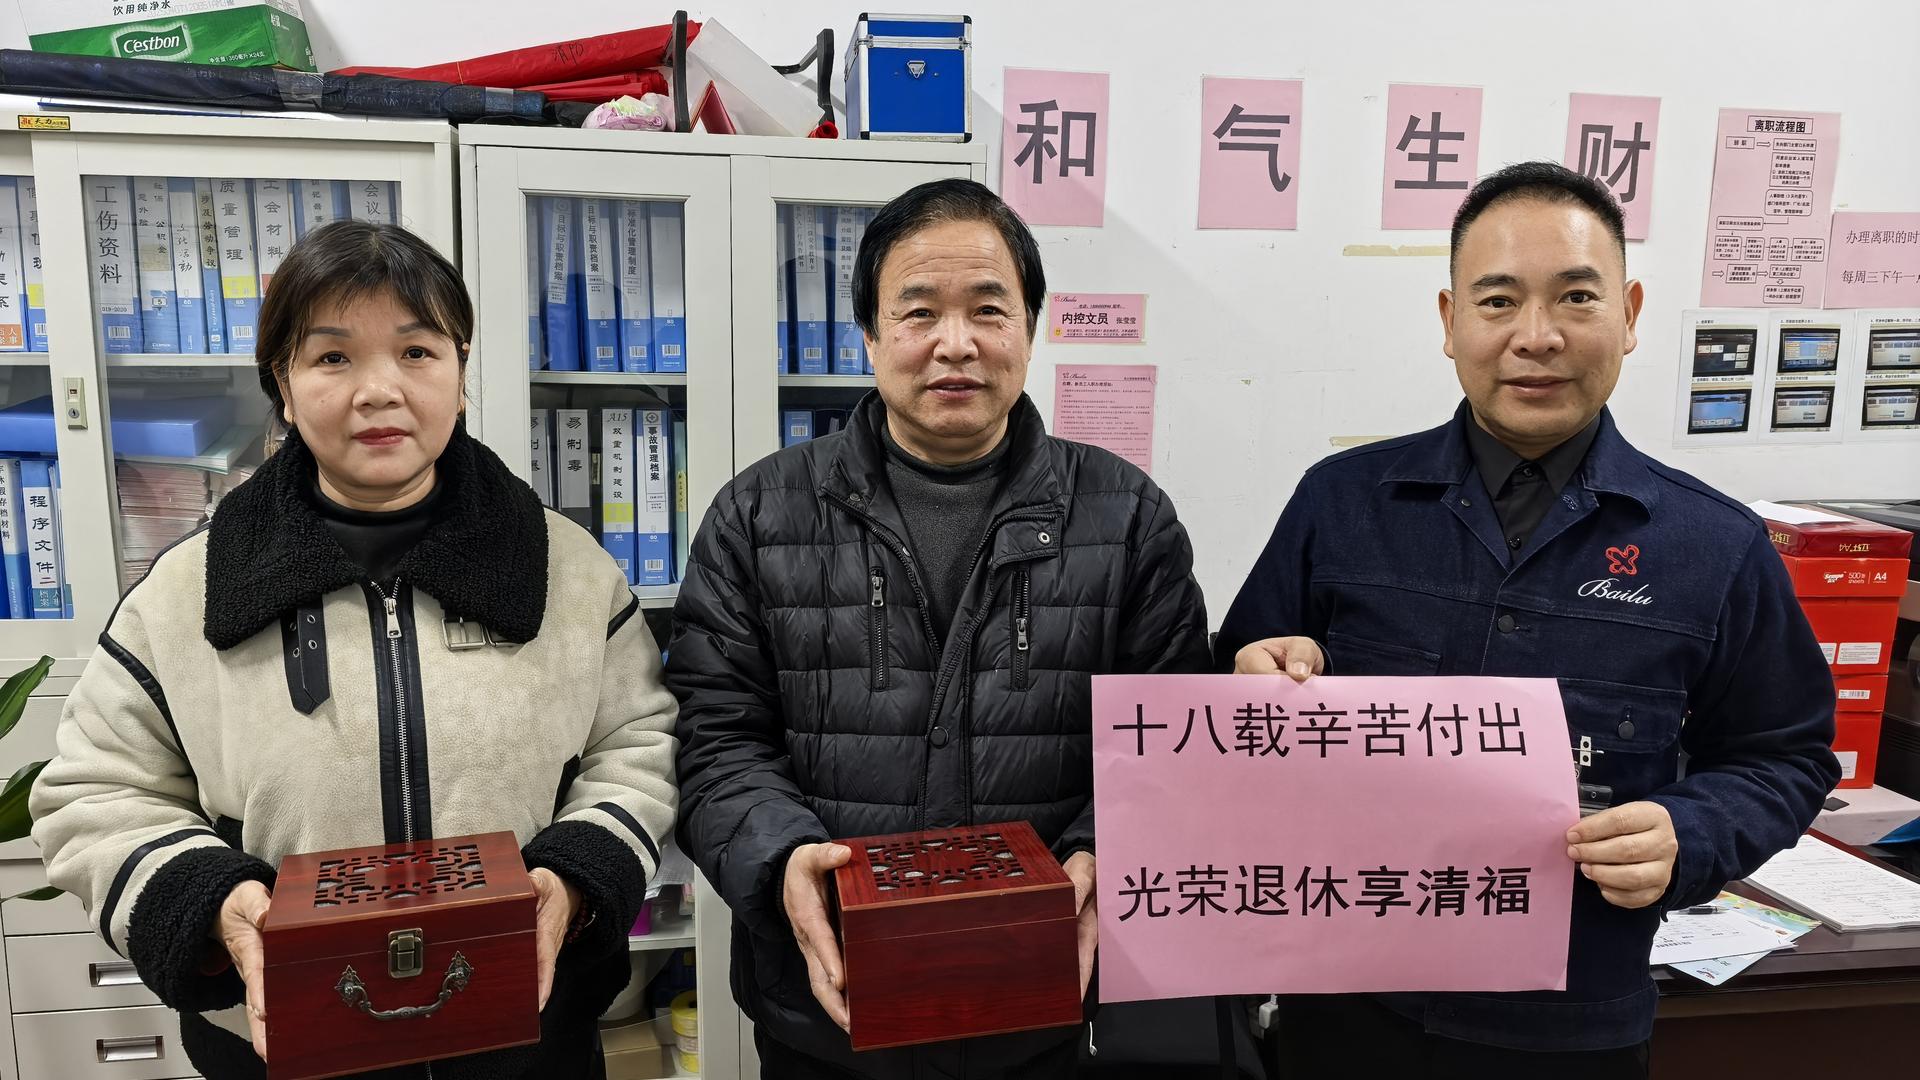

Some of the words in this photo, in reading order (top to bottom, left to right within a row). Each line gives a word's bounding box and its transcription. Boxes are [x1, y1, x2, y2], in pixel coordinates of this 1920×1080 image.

[112, 1, 171, 16] 饮用纯净水
[1014, 99, 1097, 185] 和
[1213, 104, 1292, 192] 气
[1394, 112, 1469, 190] 生
[1577, 122, 1651, 203] 财
[1755, 119, 1806, 133] 离职流程图
[96, 186, 122, 284] 工伤资料
[220, 181, 243, 260] 质量管理
[263, 180, 283, 258] 工会材料
[588, 205, 599, 272] 目标与职责档案
[627, 209, 637, 275] 标准化管理制度
[1846, 230, 1920, 244] 办理离职的时
[1062, 312, 1109, 325] 内控文员
[566, 416, 582, 472] 易制毒
[607, 412, 628, 423] A15
[612, 427, 623, 499] 双重机制建设
[648, 427, 660, 481] 事故管理档案
[1577, 577, 1654, 605] Bailu
[1874, 572, 1888, 581] A4
[1112, 702, 1528, 758] 十八载辛苦付出
[1117, 864, 1532, 922] 光荣退休享清福
